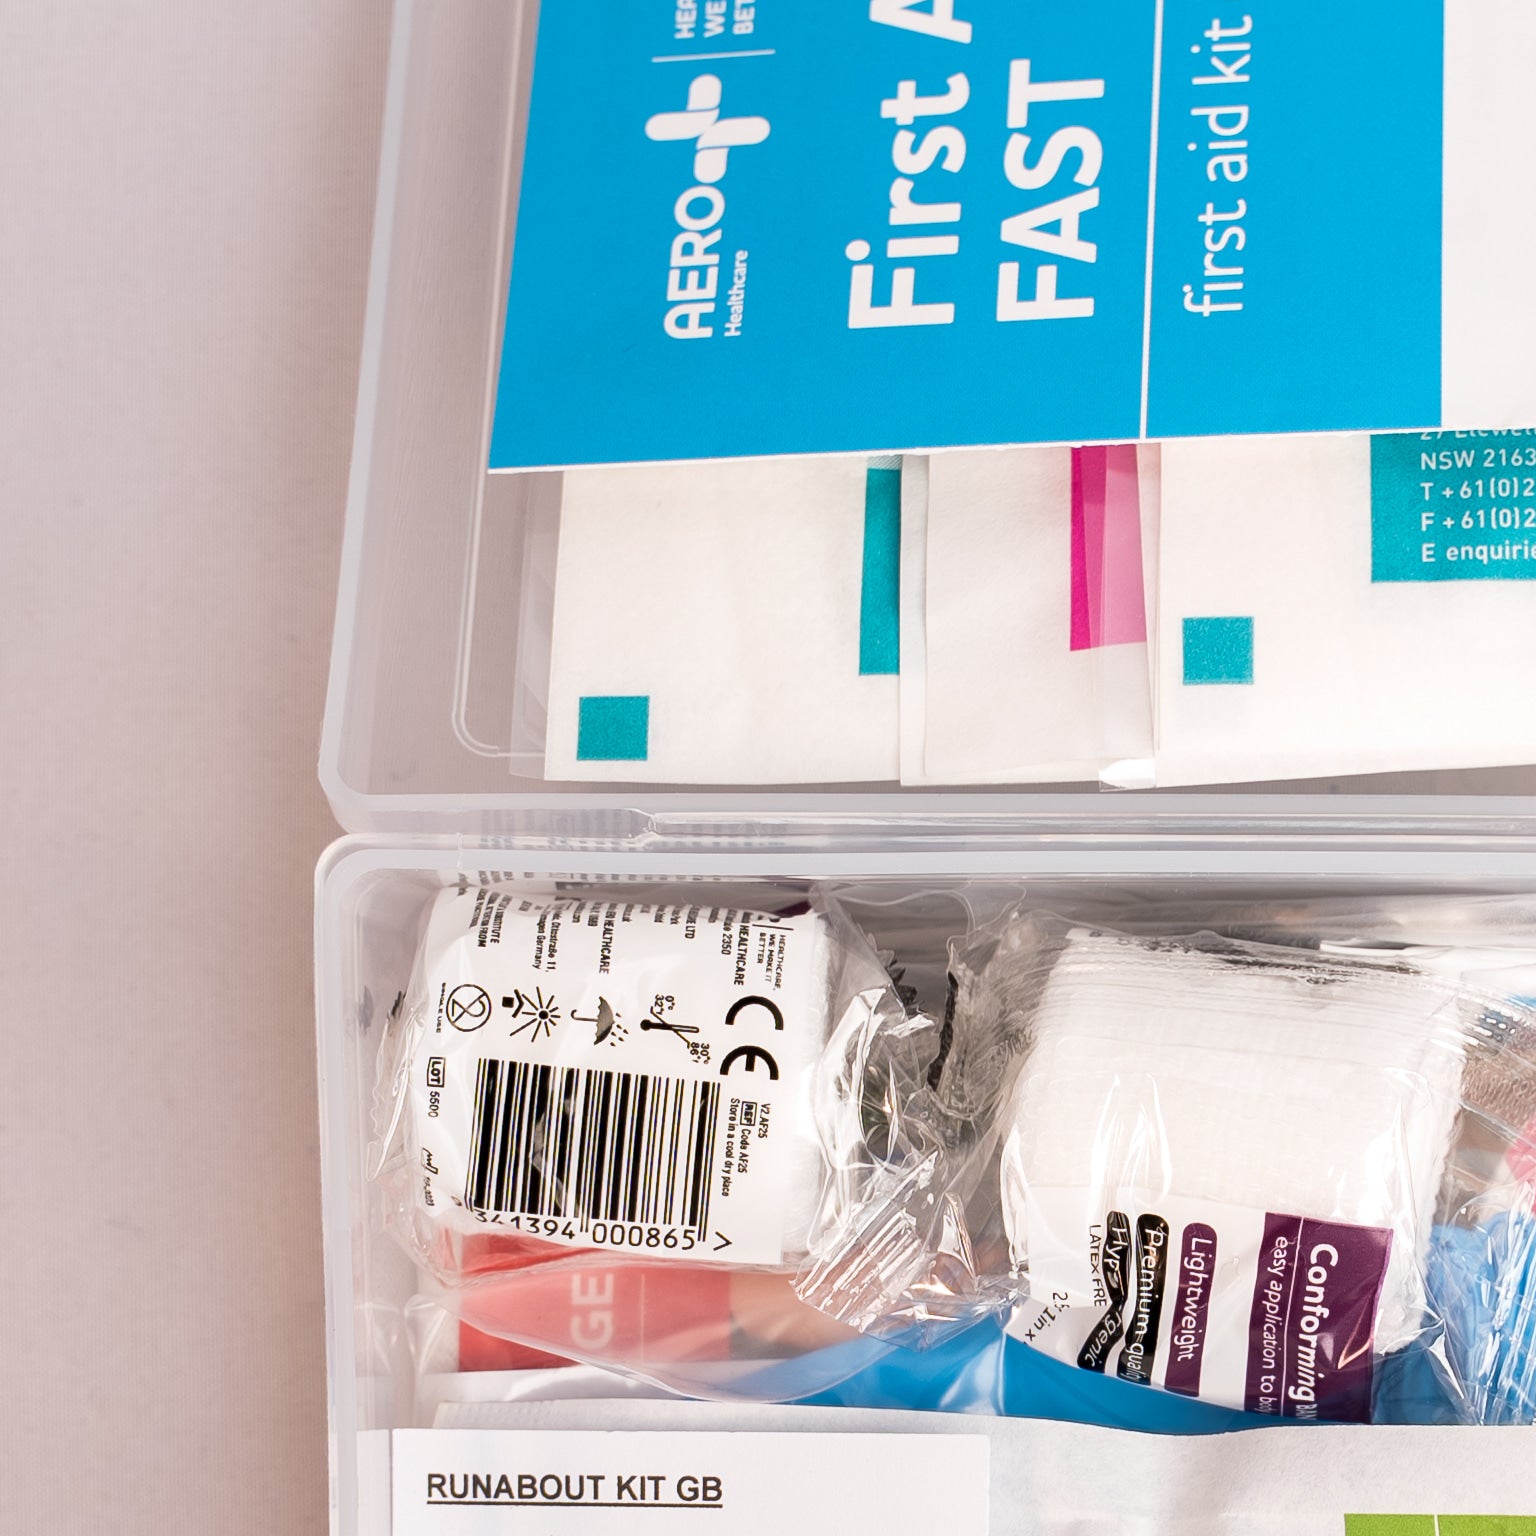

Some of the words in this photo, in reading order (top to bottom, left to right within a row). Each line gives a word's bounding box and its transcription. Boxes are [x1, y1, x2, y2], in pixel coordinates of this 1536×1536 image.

[704, 2, 726, 37] WE
[1190, 15, 1251, 92] kit
[1187, 105, 1249, 182] aid
[844, 71, 970, 329] First
[996, 59, 1105, 323] FAST
[663, 184, 726, 339] AERO
[1183, 200, 1248, 317] first
[724, 250, 748, 337] Healthcare
[1420, 449, 1475, 470] NSW
[1484, 448, 1536, 467] 2163
[1420, 483, 1433, 501] T
[1422, 544, 1435, 562] E
[734, 925, 750, 986] HEALTHCARE
[428, 1091, 440, 1117] 5500
[430, 1060, 442, 1084] LOT
[592, 1223, 696, 1250] 000865
[1268, 1236, 1288, 1277] easy
[1136, 1228, 1163, 1334] Premium
[1174, 1237, 1212, 1362] Lightweight
[1261, 1280, 1283, 1369] application
[1288, 1243, 1339, 1402] Conforming
[1261, 1376, 1276, 1393] to
[427, 1473, 606, 1501] RUNABOUT
[616, 1475, 666, 1501] KIT
[676, 1475, 723, 1502] GB
